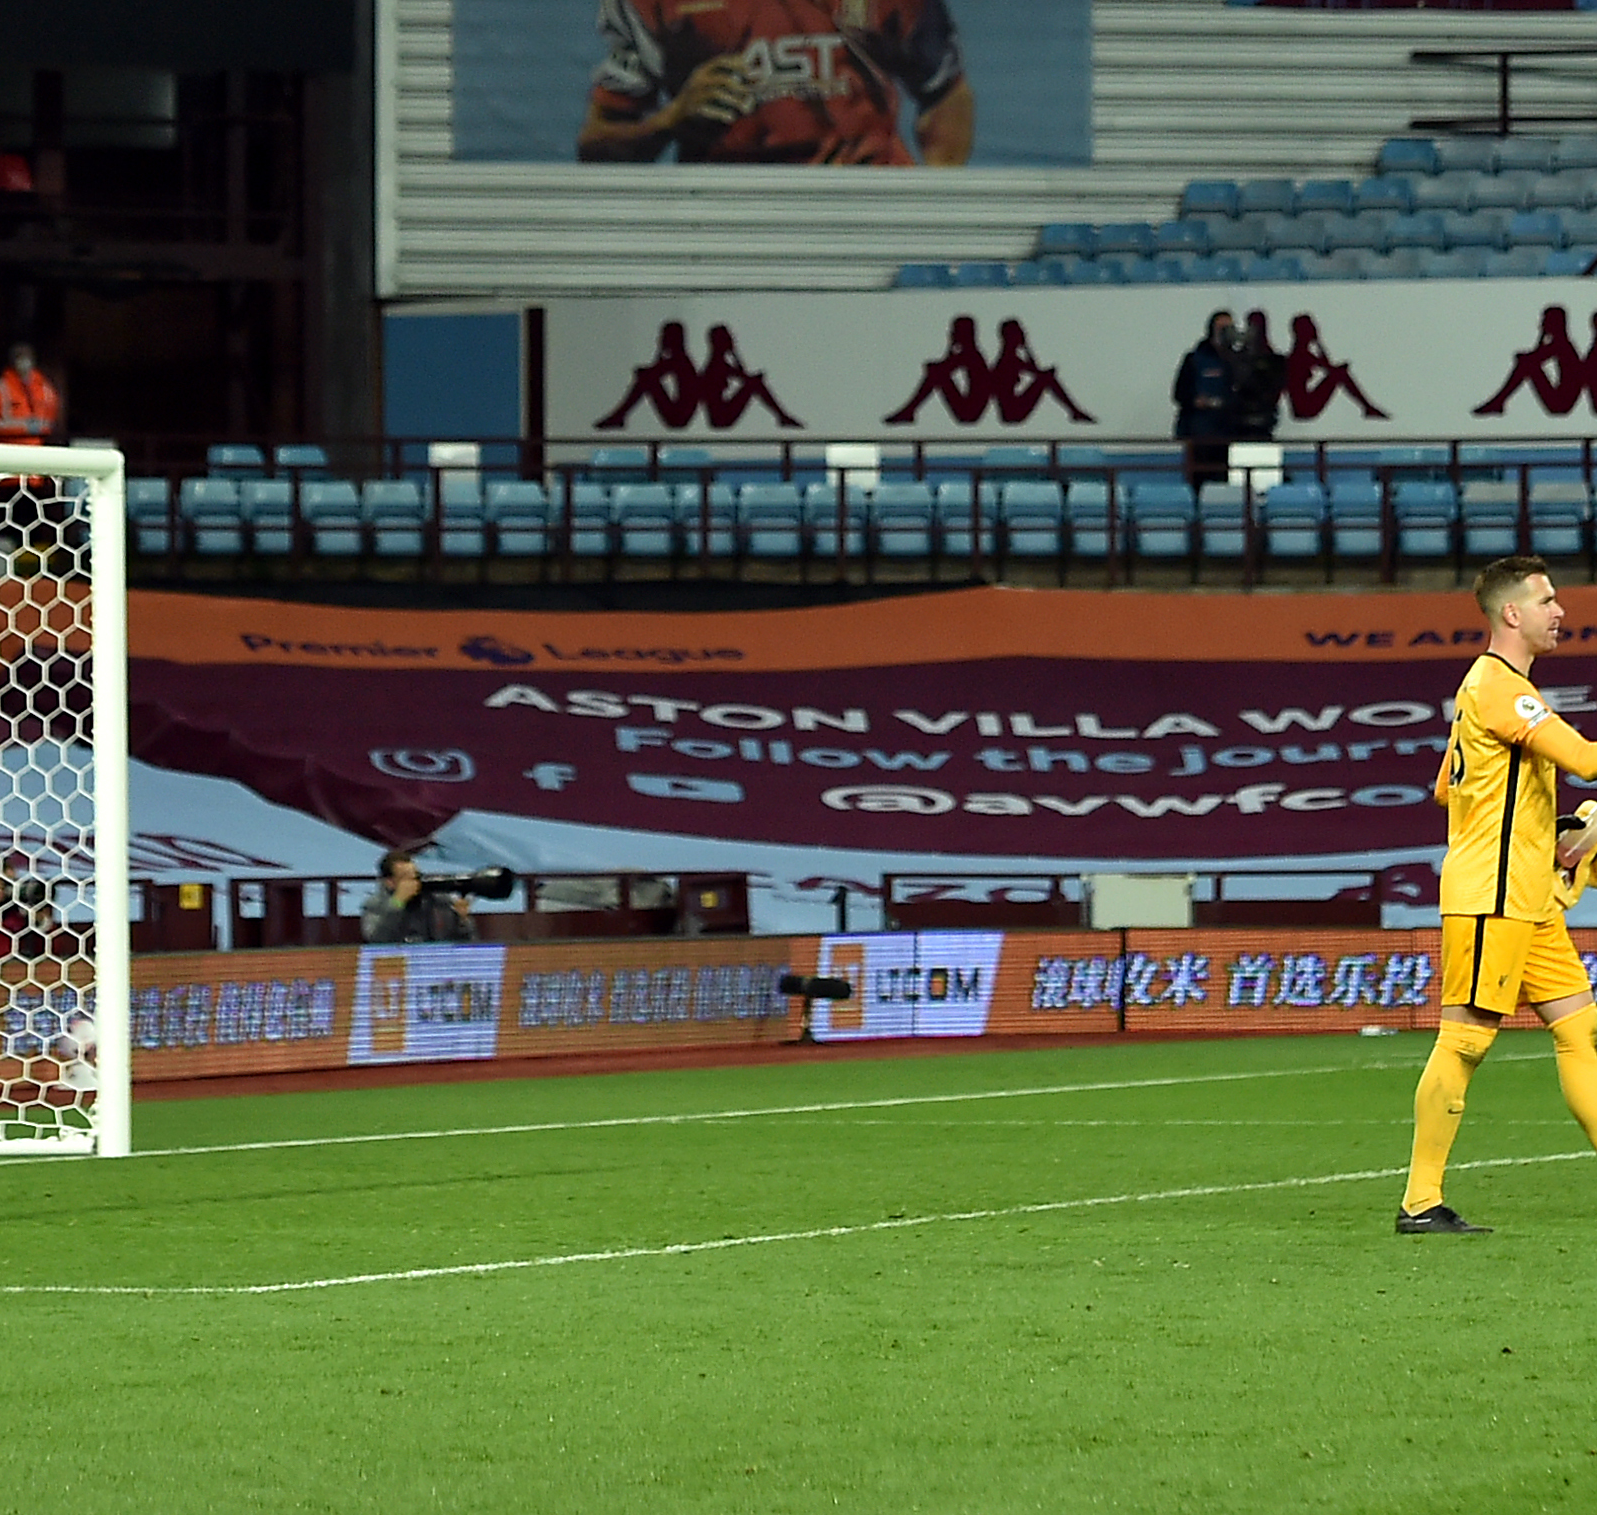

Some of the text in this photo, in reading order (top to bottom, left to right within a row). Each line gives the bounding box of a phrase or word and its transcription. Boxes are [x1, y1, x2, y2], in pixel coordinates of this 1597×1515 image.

[241, 633, 747, 664] Premier League
[1305, 631, 1395, 648] WE
[1408, 629, 1486, 647] AR
[485, 684, 870, 734] ASTON
[892, 708, 1222, 740] VILLA
[614, 725, 953, 771] Follow
[974, 745, 1157, 775] the
[1227, 952, 1436, 1008] 首选乐投
